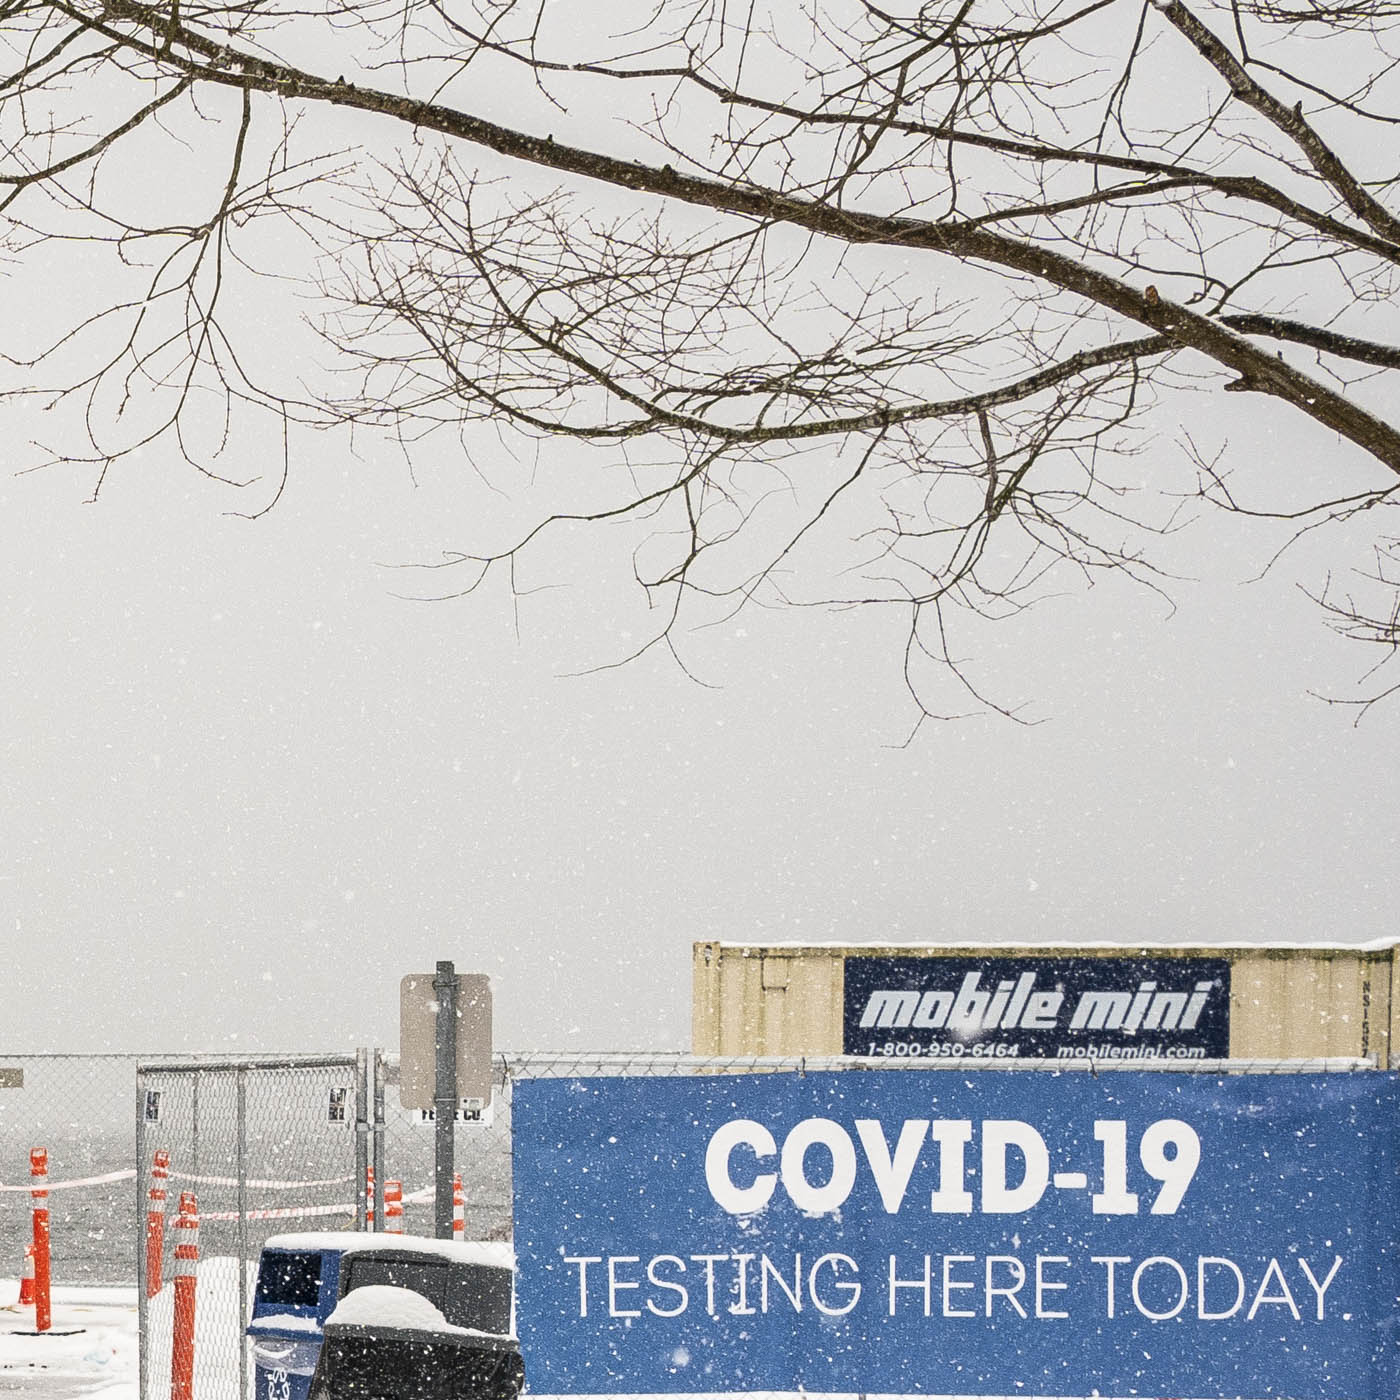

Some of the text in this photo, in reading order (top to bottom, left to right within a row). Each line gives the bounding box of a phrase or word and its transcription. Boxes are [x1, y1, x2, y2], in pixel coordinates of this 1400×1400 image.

[859, 972, 1213, 1030] mobile mini
[868, 1043, 1206, 1058] 1-800-950-6464 mobilemini.com
[705, 1119, 1201, 1216] COVID-19
[564, 1254, 862, 1320] TESTING
[889, 1254, 1070, 1319] HERE
